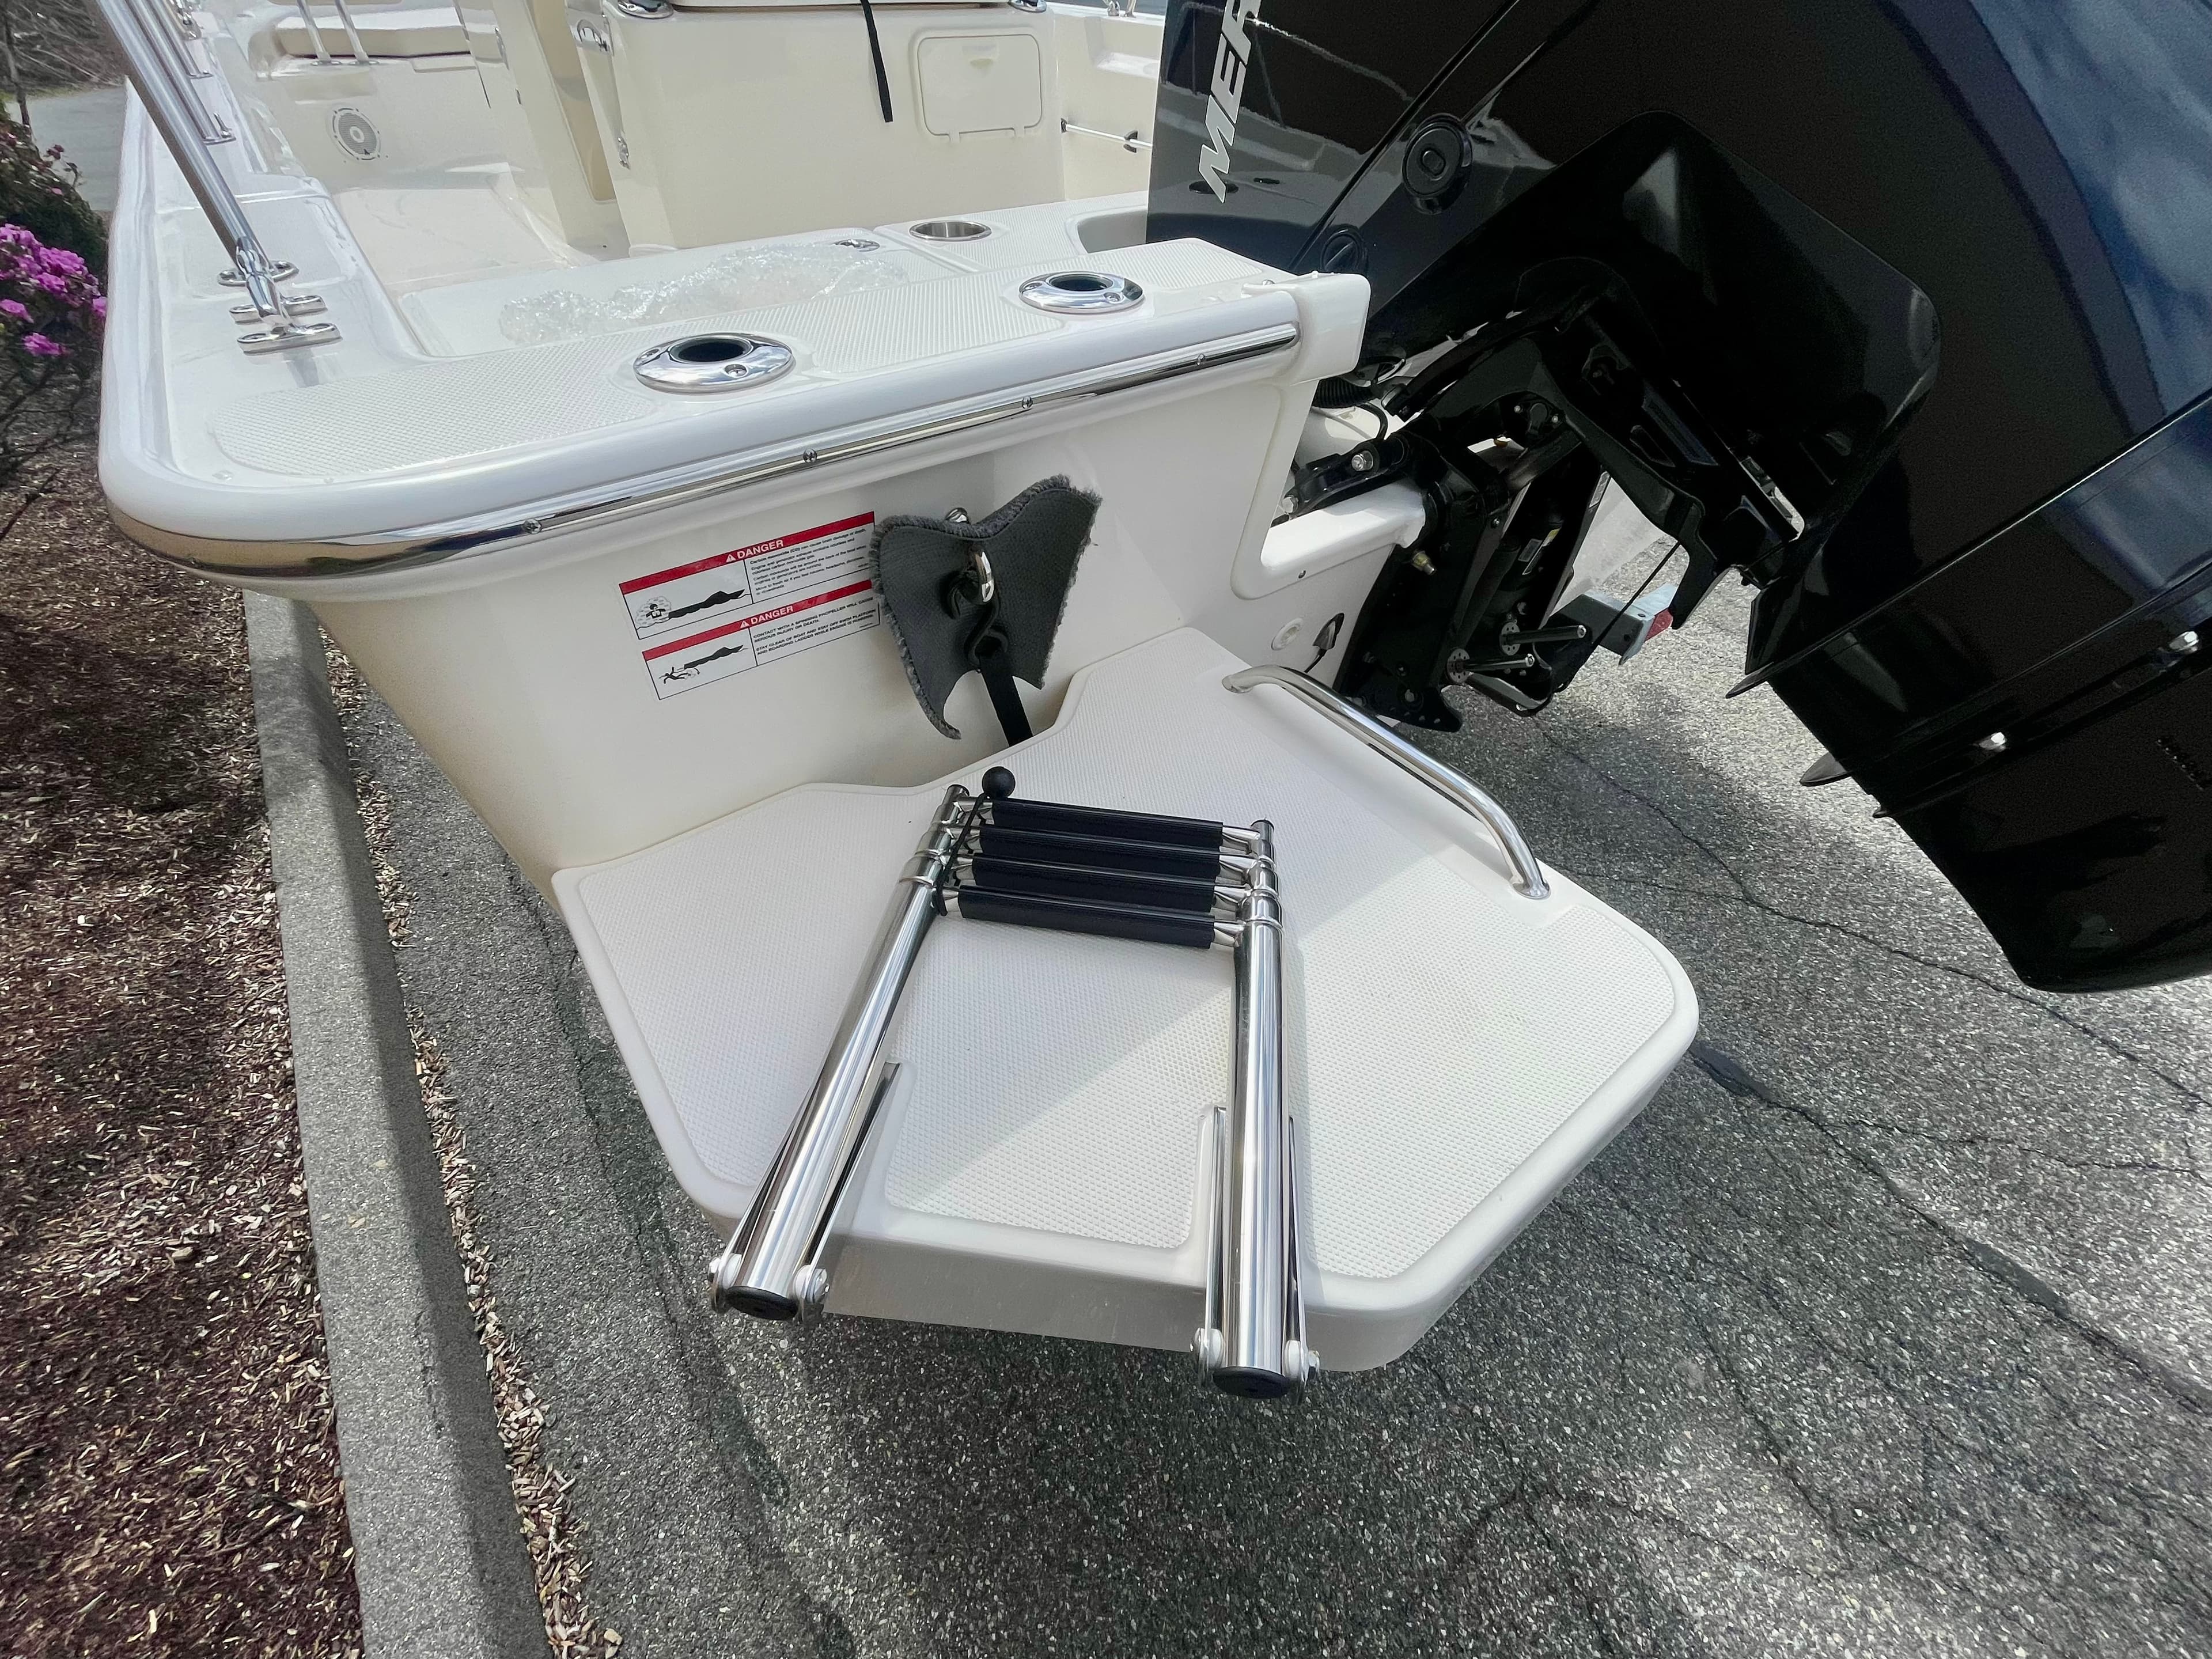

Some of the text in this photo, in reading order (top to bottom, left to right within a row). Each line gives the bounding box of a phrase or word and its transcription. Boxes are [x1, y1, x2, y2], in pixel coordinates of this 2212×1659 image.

[737, 540, 783, 559] DANGER
[751, 606, 793, 624] DANGER
[753, 628, 776, 638] CONTACT
